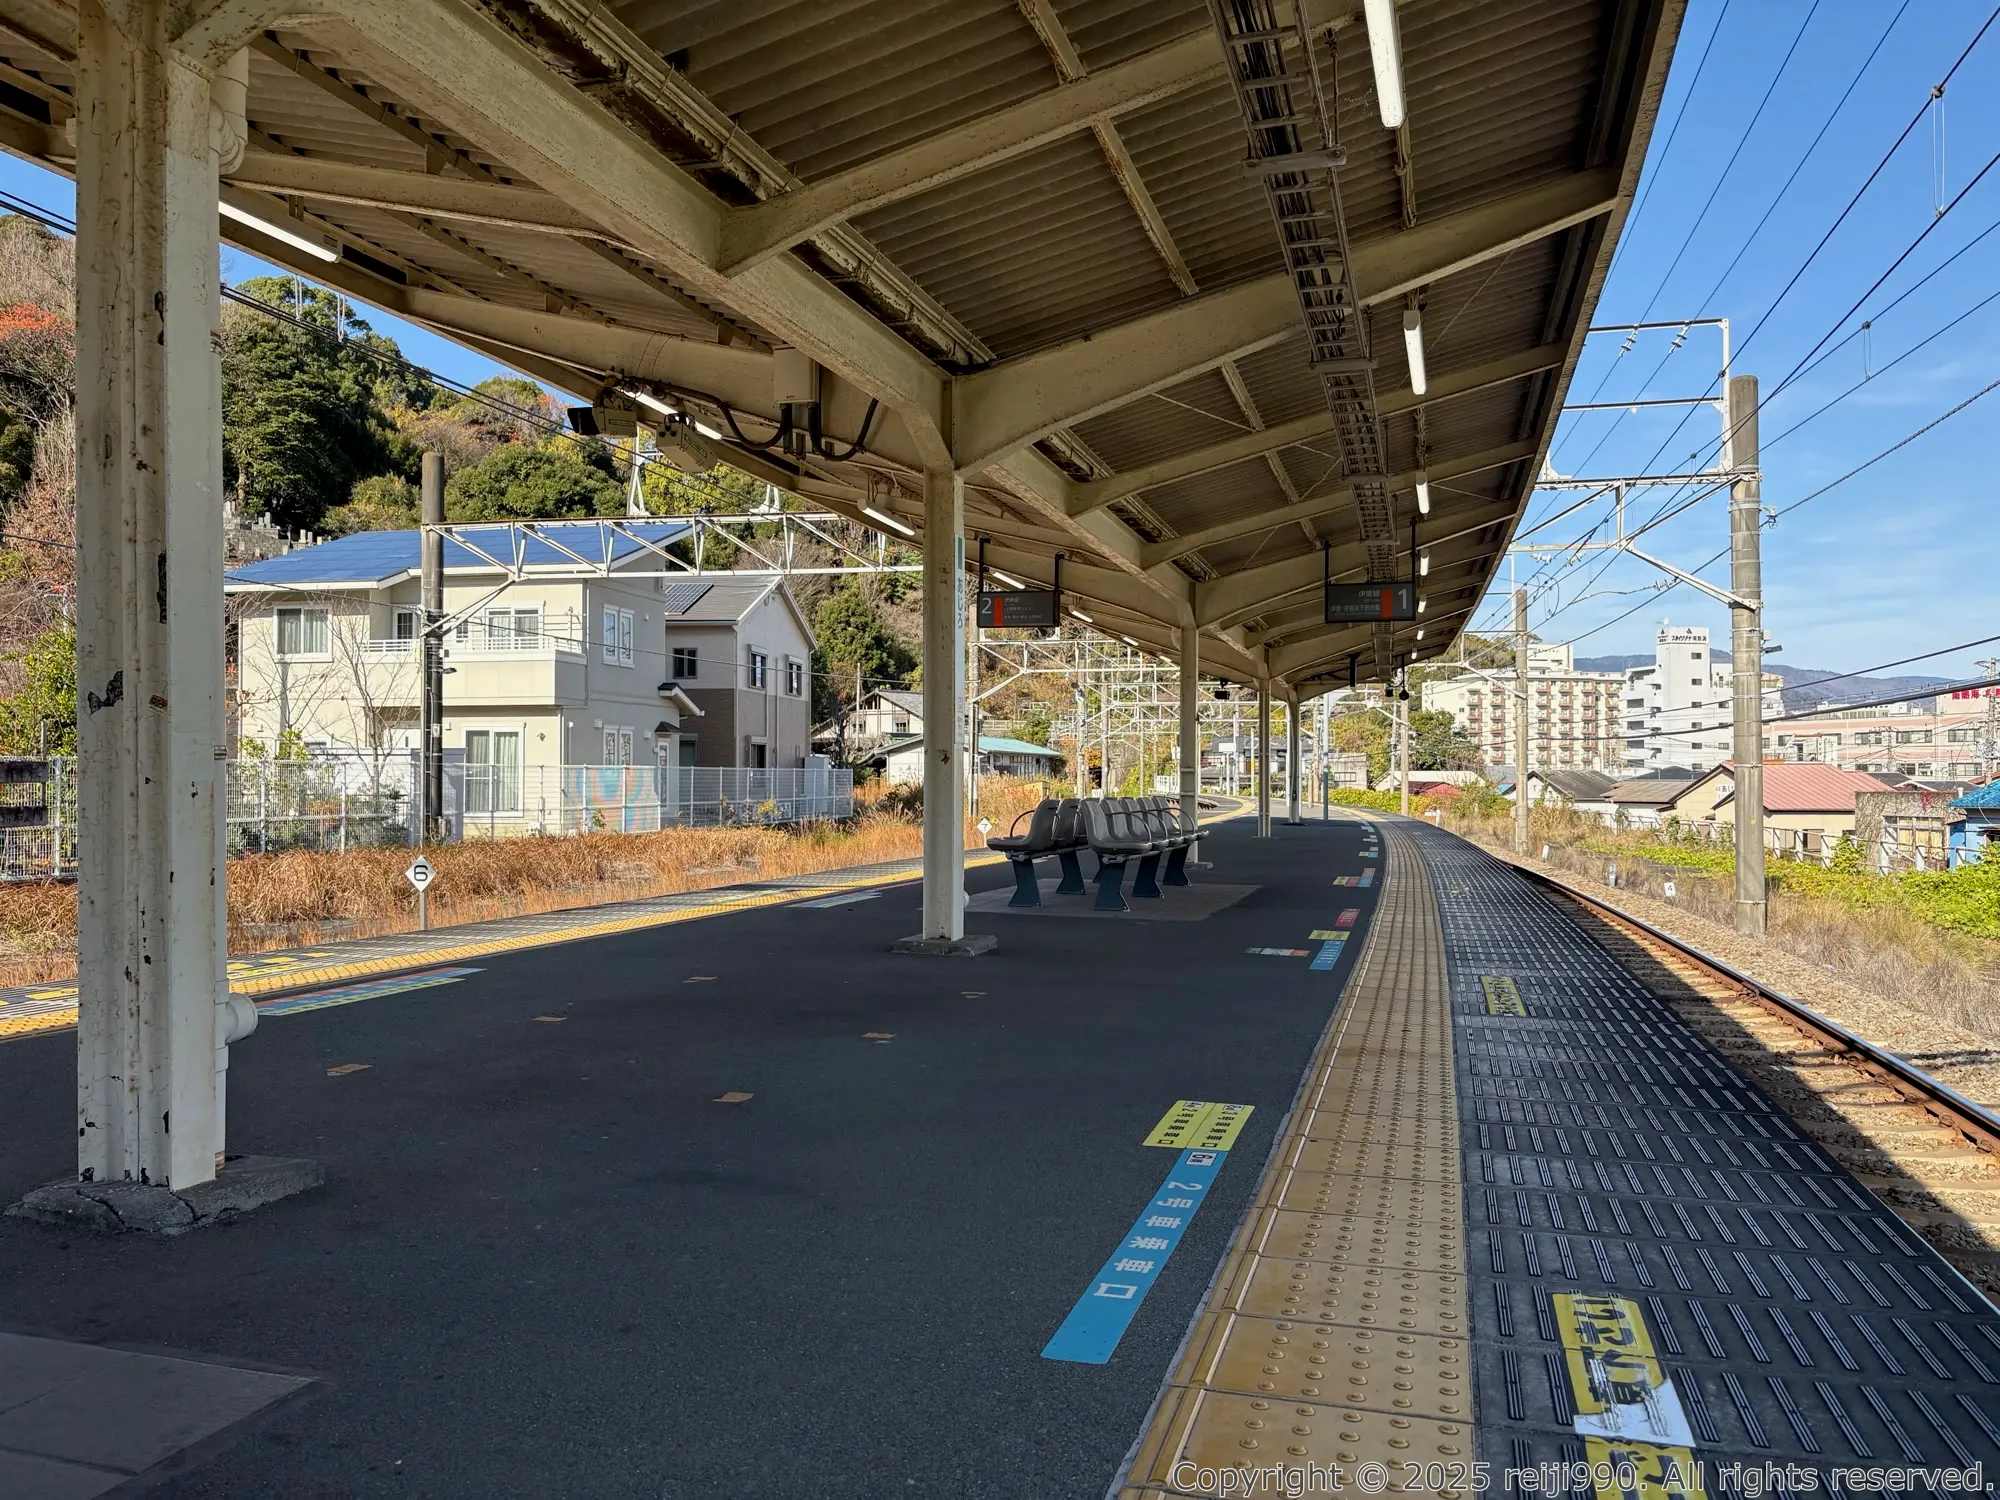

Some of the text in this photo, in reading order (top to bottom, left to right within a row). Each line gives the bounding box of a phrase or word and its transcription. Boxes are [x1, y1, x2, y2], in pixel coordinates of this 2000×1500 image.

[1358, 589, 1380, 597] 伊東線
[1397, 588, 1407, 610] 1
[981, 597, 992, 614] 2
[981, 823, 988, 831] 7
[413, 864, 429, 882] 6
[1157, 1108, 1198, 1145] 2号車乗車口
[1093, 1180, 1203, 1300] 2号車乗車口
